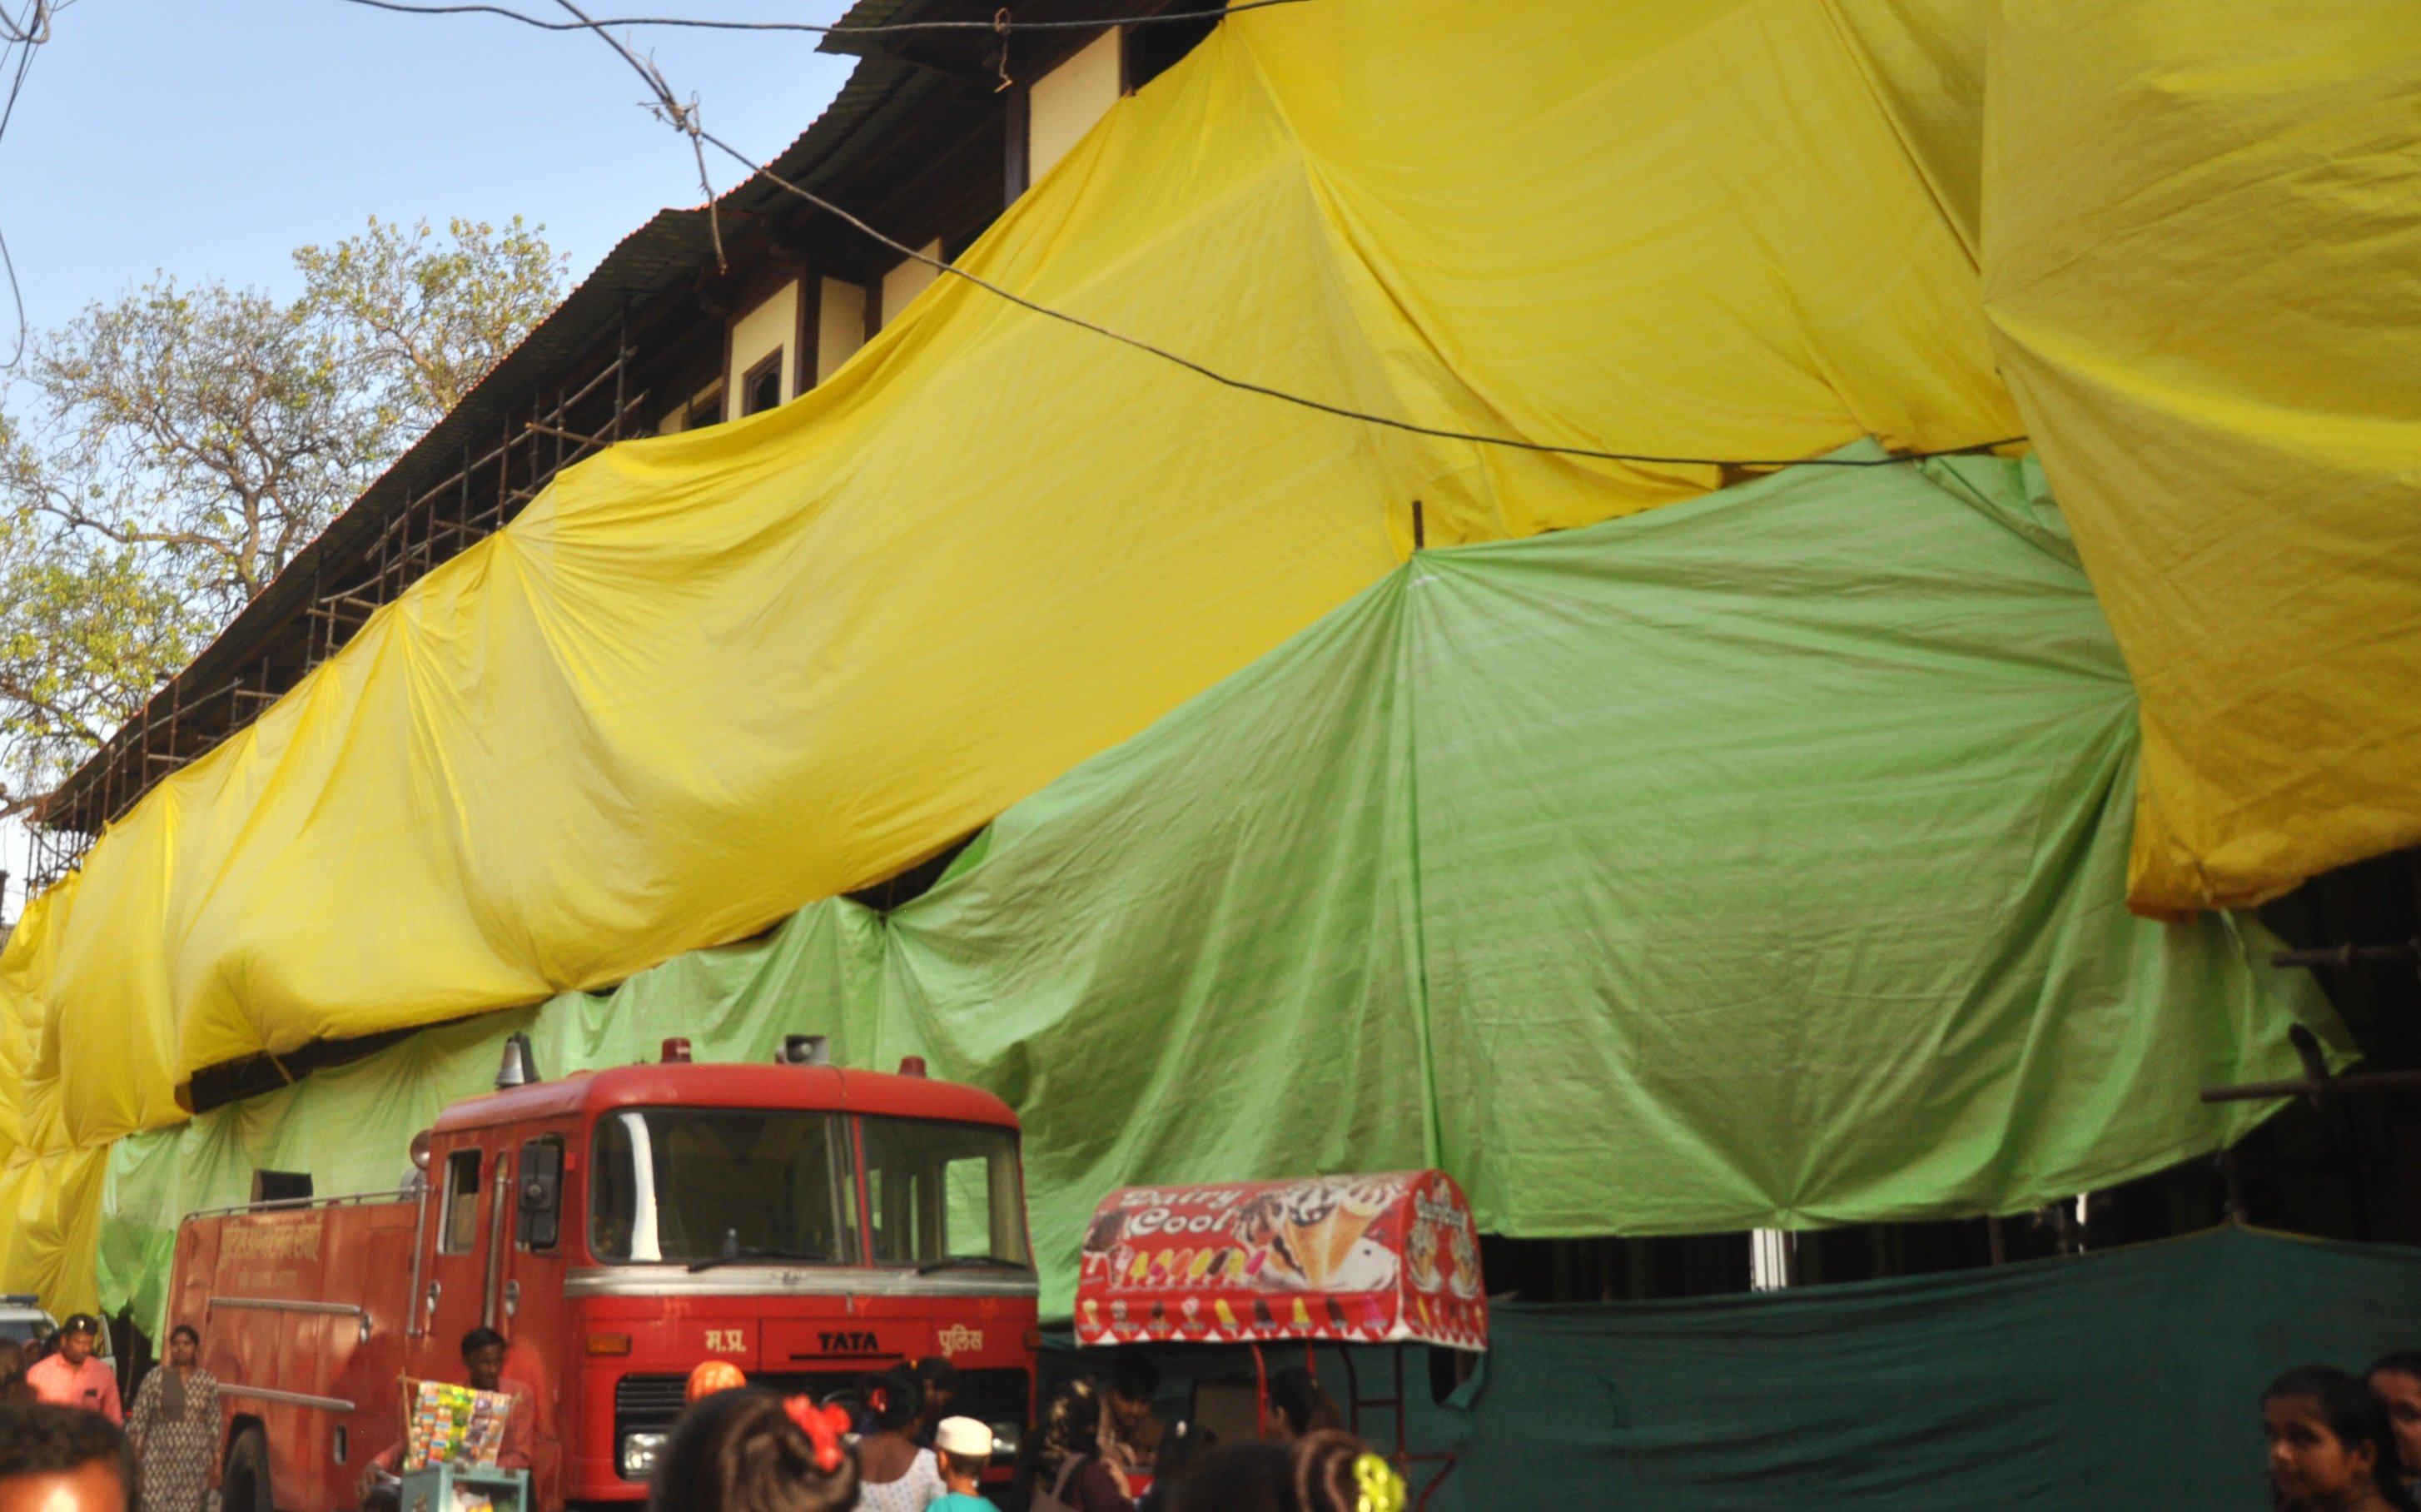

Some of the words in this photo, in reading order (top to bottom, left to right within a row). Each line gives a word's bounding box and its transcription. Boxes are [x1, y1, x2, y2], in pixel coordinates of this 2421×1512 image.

[1120, 1190, 1245, 1209] Dairy
[1131, 1207, 1237, 1235] Cool
[818, 1331, 879, 1351] TATA
[937, 1324, 983, 1357] पुलिस
